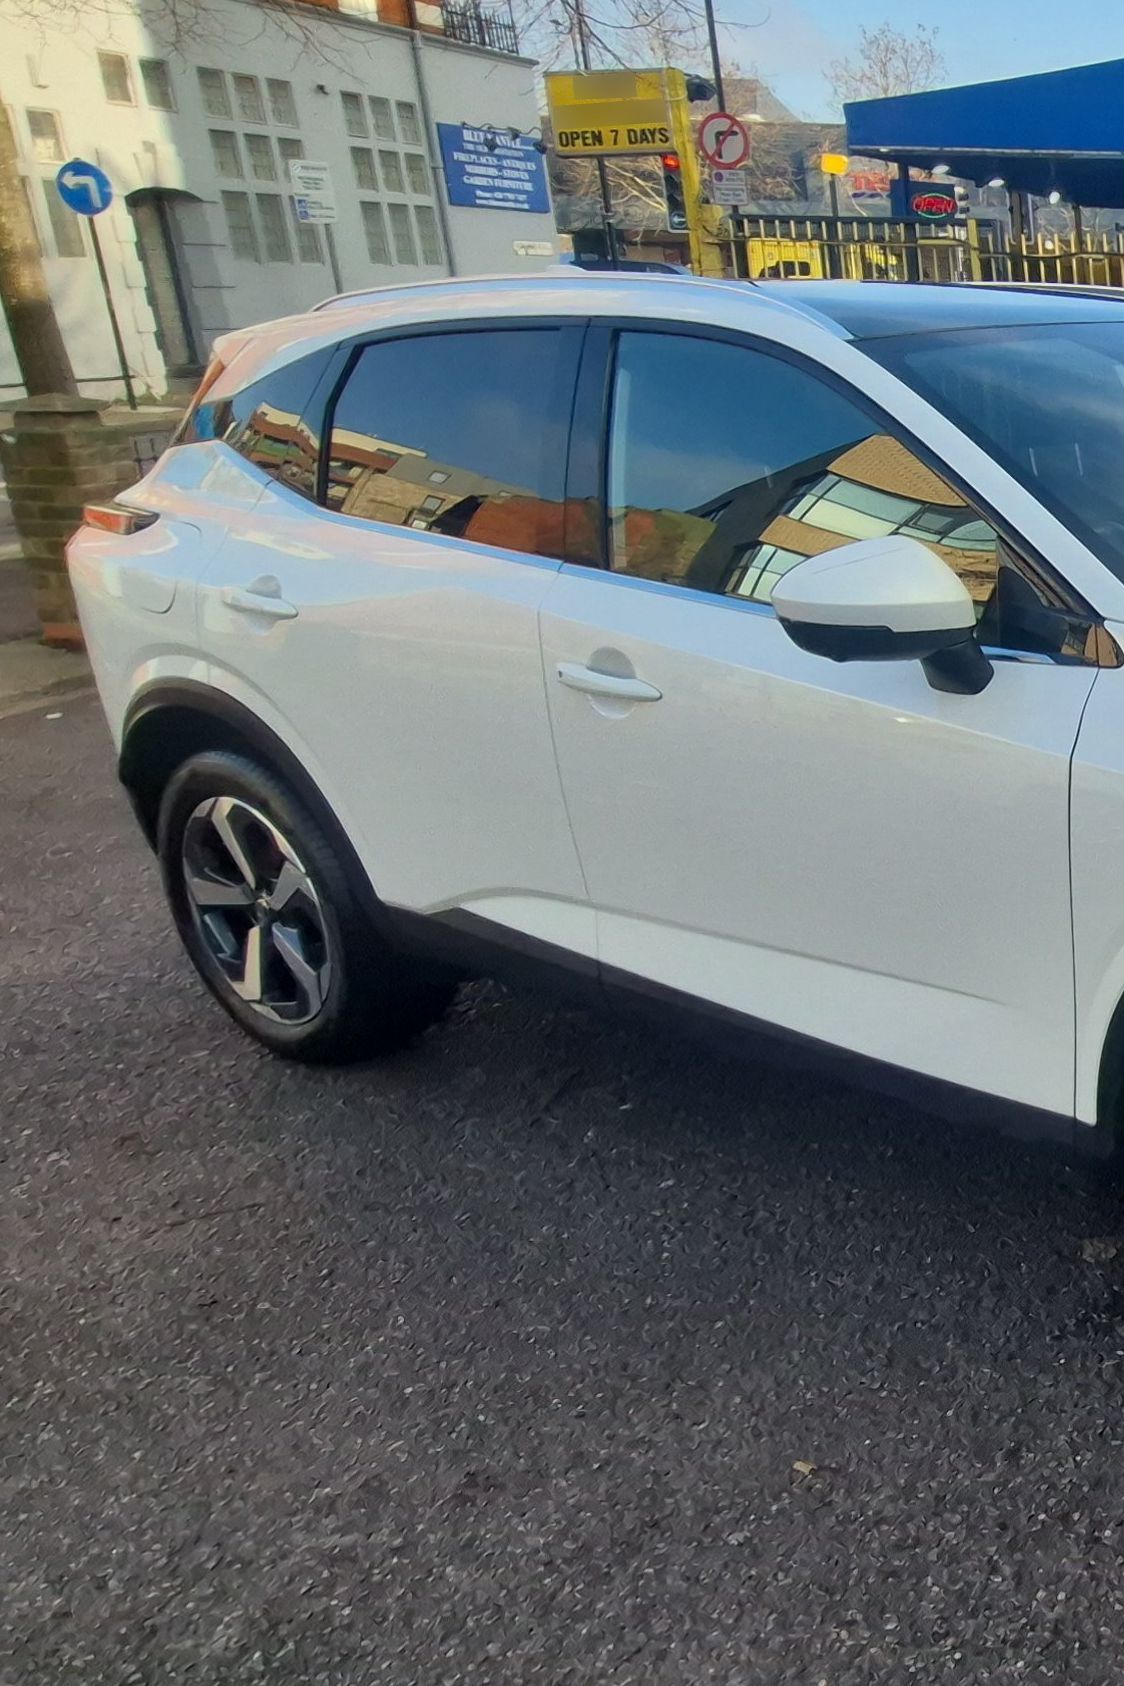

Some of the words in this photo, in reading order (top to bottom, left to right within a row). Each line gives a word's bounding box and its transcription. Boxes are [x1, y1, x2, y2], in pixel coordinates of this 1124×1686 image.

[559, 130, 604, 147] OPEN
[610, 129, 619, 145] 7
[627, 127, 669, 145] DAYS
[913, 196, 956, 214] OPEN
